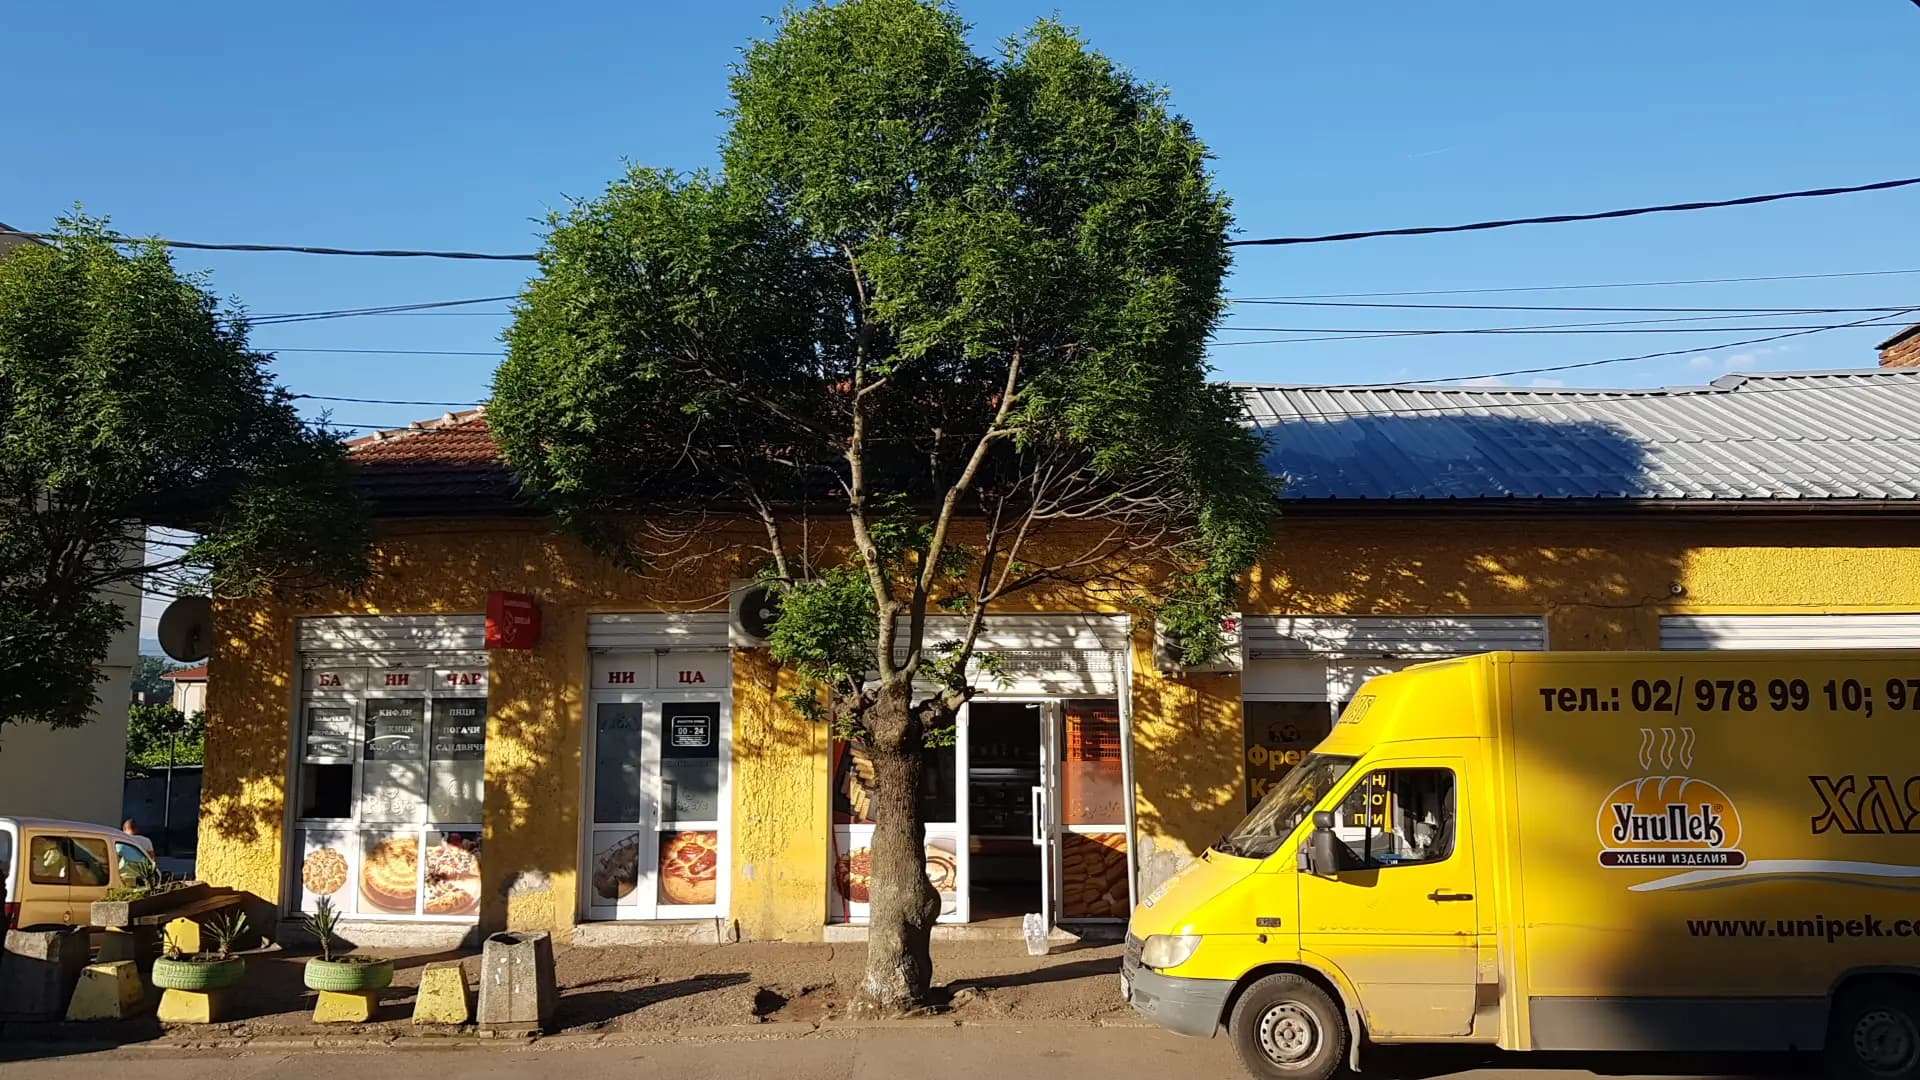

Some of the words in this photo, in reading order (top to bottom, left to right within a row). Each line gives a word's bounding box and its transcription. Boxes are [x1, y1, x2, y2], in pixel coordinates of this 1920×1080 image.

[319, 673, 342, 686] БА
[385, 673, 409, 686] НИ
[446, 672, 482, 686] ЧАР
[608, 671, 635, 684] НИ
[678, 671, 706, 685] ЦА
[1539, 687, 1620, 712] тел.:
[1631, 676, 1684, 716] 02/
[1695, 678, 1757, 712] 978
[1768, 678, 1810, 712] 99
[1823, 678, 1873, 719] 10;
[379, 708, 413, 717] КИФЛИ
[449, 708, 476, 717] ПИЦИ
[443, 726, 481, 734] ПОГАЧИ
[694, 727, 704, 735] 24
[1617, 853, 1666, 864] ХЛЕБНИ
[1671, 853, 1728, 865] ИЗДЕЛИЯ
